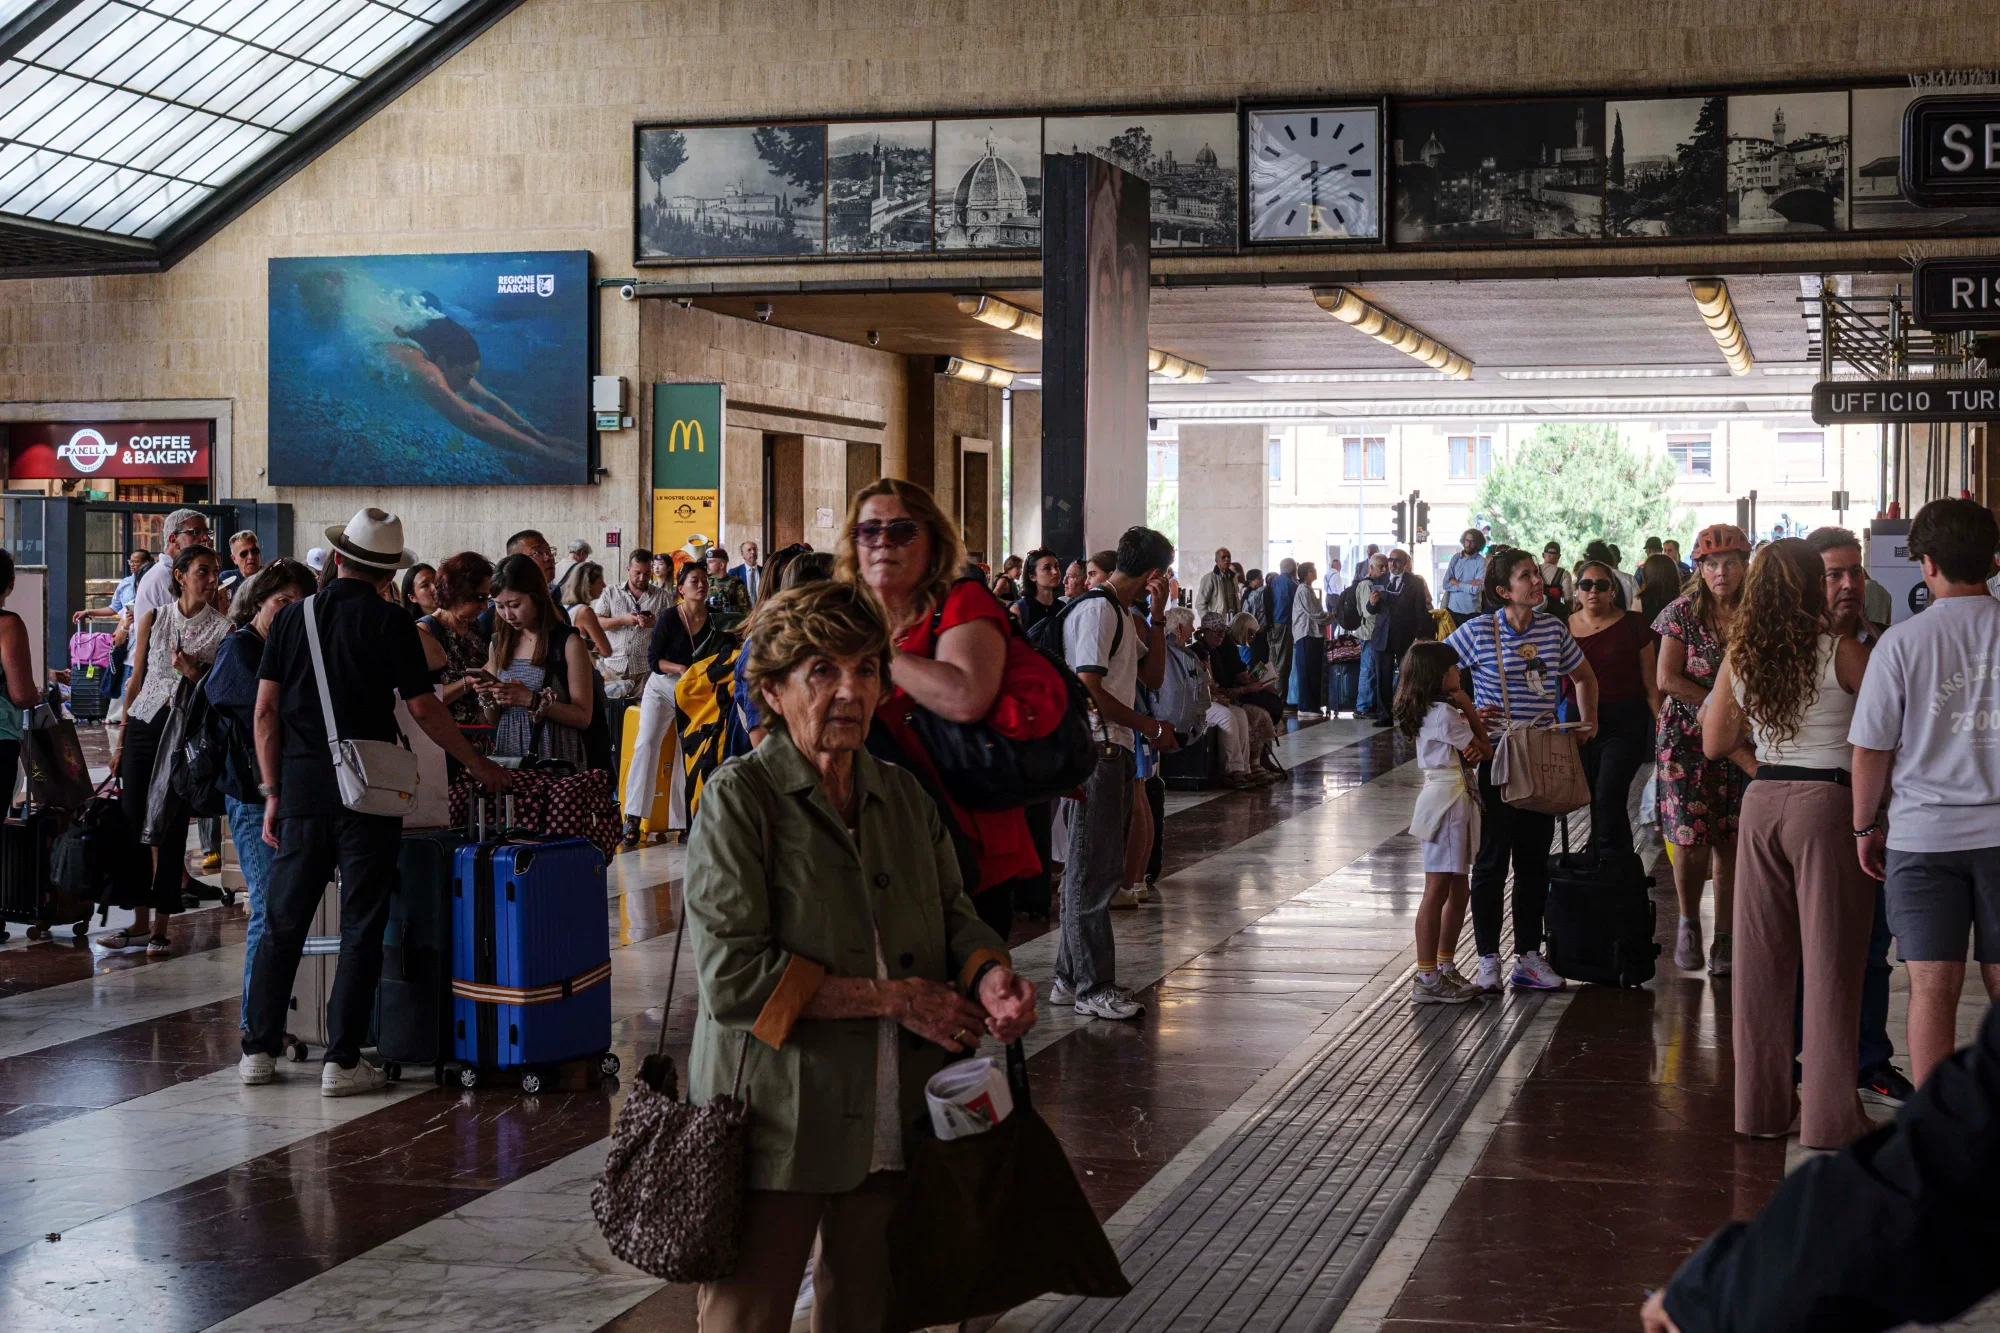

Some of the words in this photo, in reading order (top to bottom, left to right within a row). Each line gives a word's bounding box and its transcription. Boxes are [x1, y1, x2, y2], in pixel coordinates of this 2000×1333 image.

[1941, 123, 2000, 171] SE
[498, 275, 535, 284] REGIONE
[497, 284, 535, 293] MARCHE
[1952, 277, 2000, 309] RI
[1831, 391, 1931, 413] UFFICIO
[129, 435, 191, 449] COFFEE
[64, 446, 109, 455] PANELLA
[122, 450, 133, 464] &
[134, 450, 197, 464] BAKERY
[1928, 672, 1965, 717] DANS
